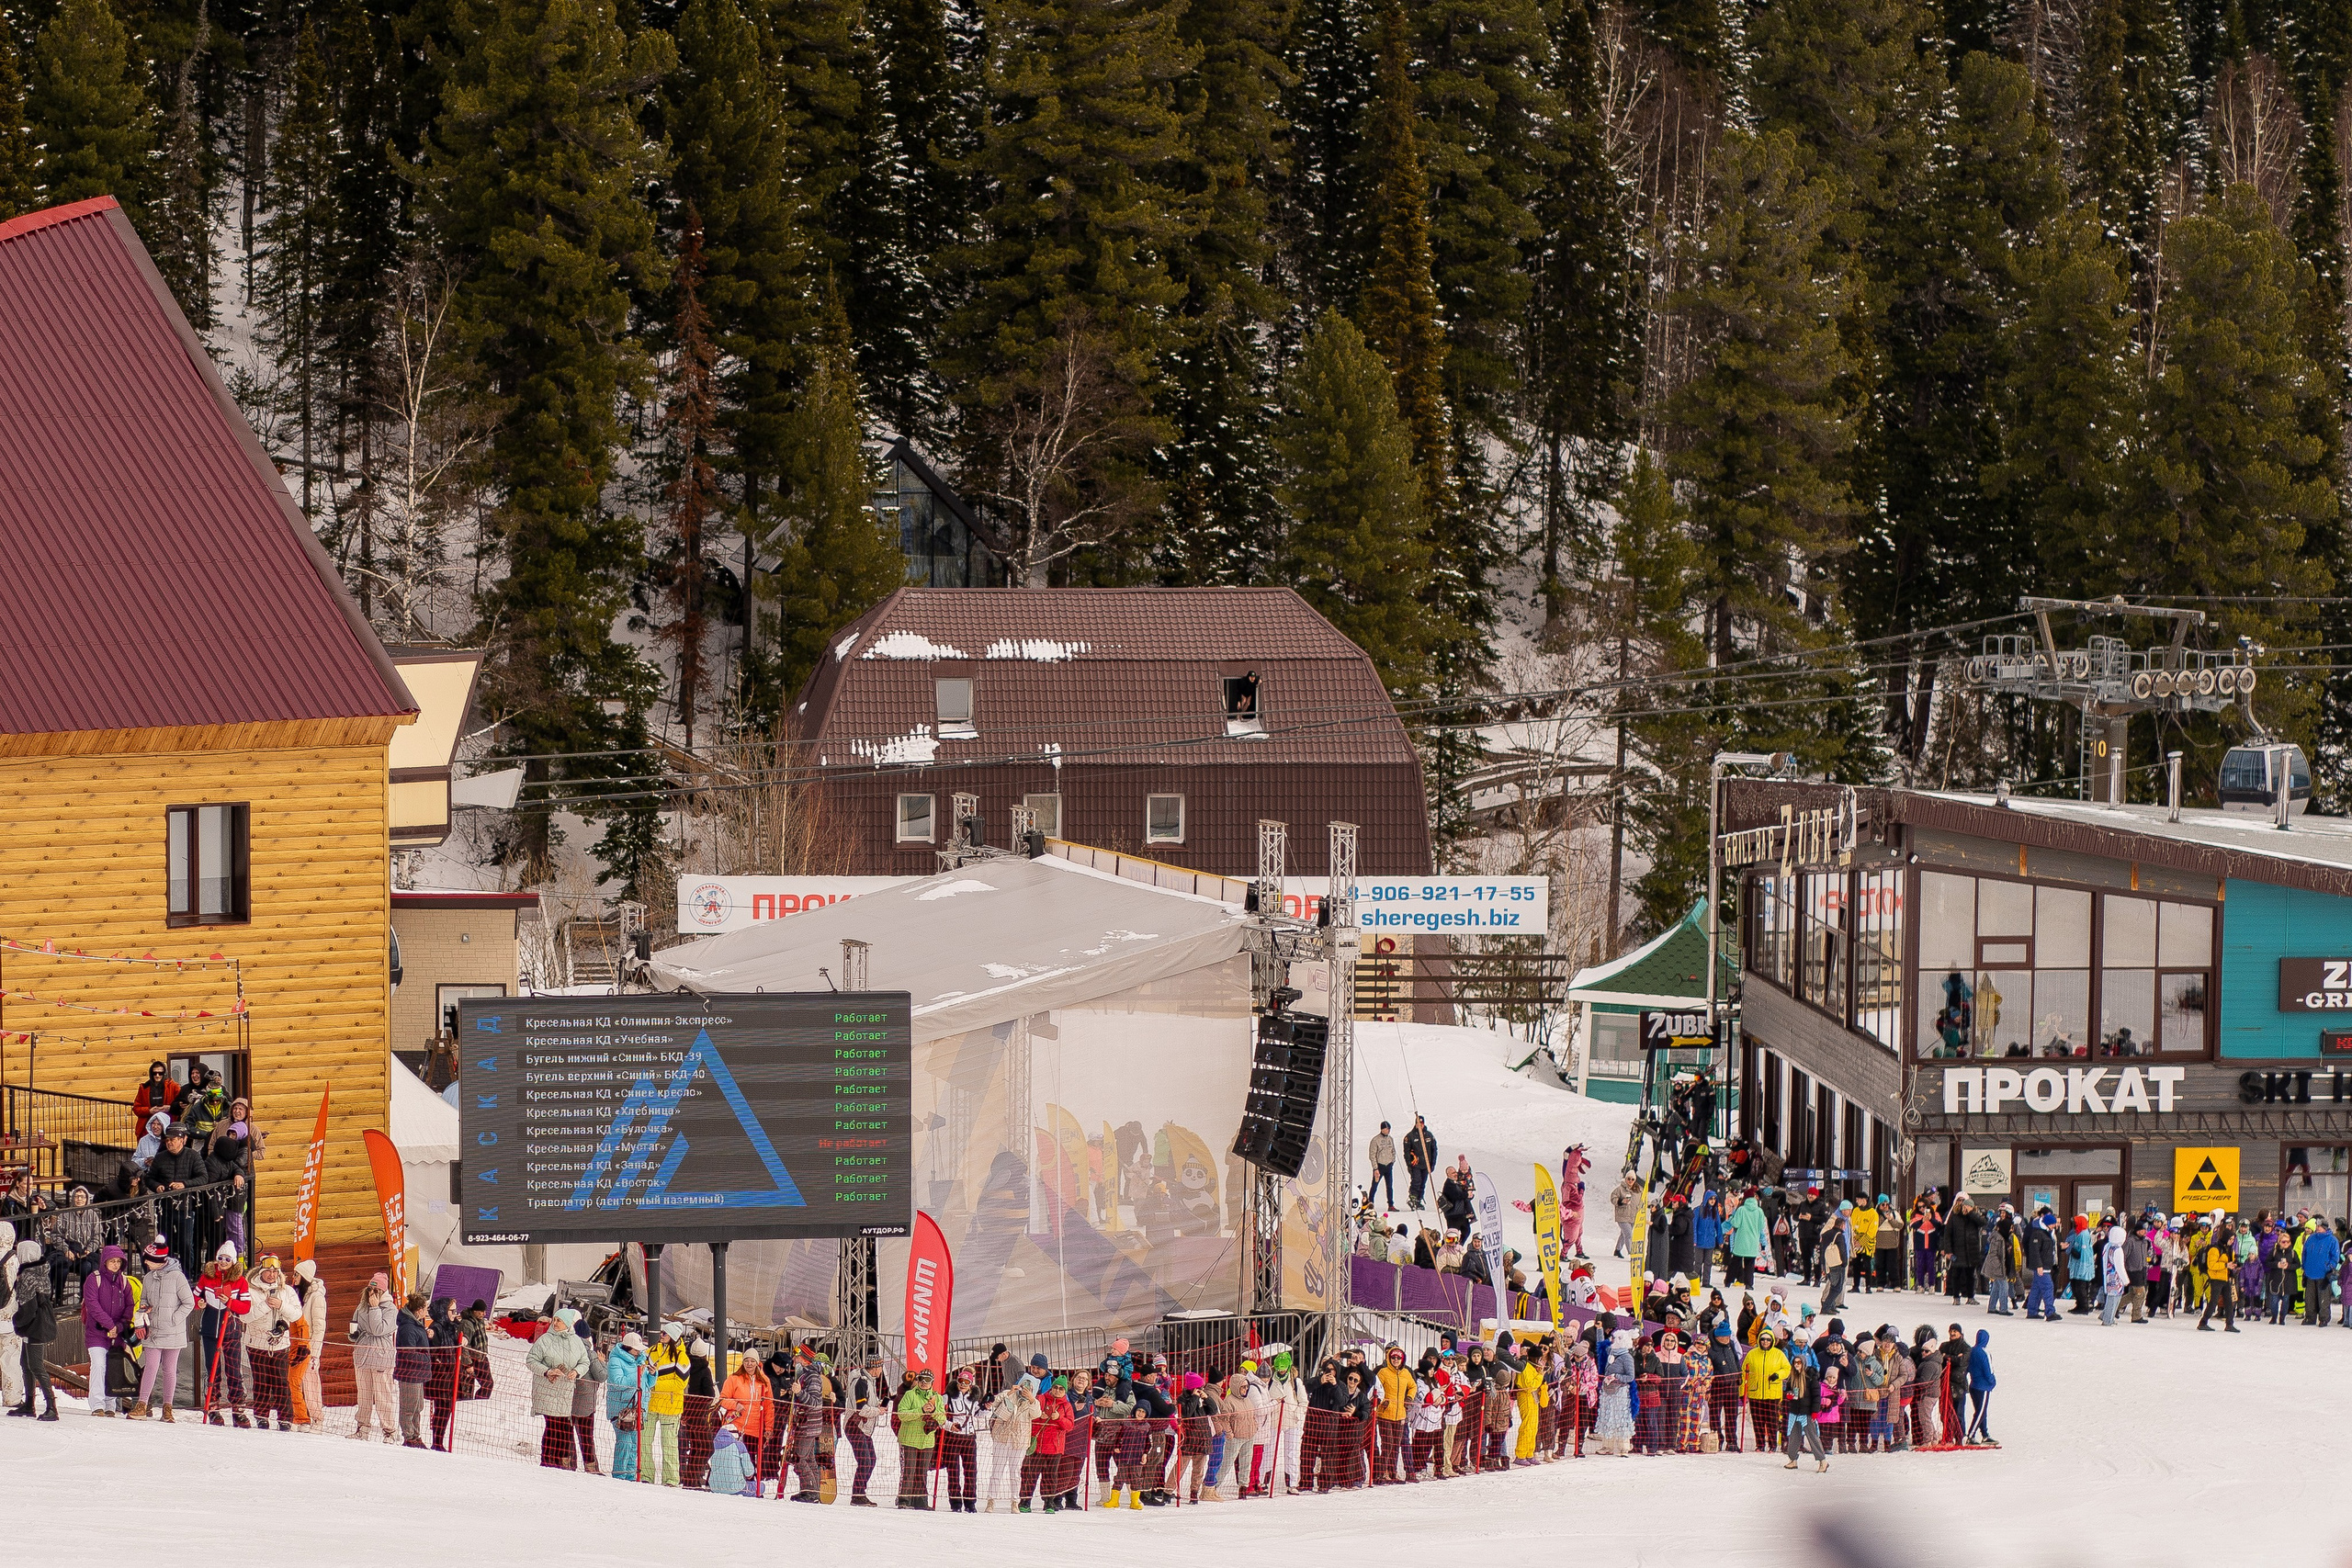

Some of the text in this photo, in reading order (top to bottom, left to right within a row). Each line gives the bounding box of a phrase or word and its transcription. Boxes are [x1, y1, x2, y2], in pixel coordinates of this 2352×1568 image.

[1725, 829, 1774, 866] GRILL BAR
[1780, 804, 1834, 878] ZUBR
[1347, 886, 1535, 901] 8-906-921-17-55
[1361, 908, 1521, 931] sheregesh.biz
[526, 1015, 733, 1030] Кресельная КД «Олимпия-Экспресс»
[834, 1013, 888, 1023] Работает
[1647, 1011, 1713, 1039] ZUBR
[526, 1033, 673, 1048] Кресельная КД «Учебная»
[834, 1031, 888, 1041] Работает
[526, 1051, 702, 1066] Бугель нижний «Синий» БКД-39
[834, 1049, 888, 1059] Работает
[526, 1069, 706, 1083] Бугель верхний «Синий» БКД-40
[834, 1066, 888, 1077] Работает
[834, 1085, 888, 1094] Работает
[1943, 1066, 2185, 1113] ПРОКАТ
[2239, 1071, 2312, 1104] SKI
[526, 1089, 703, 1101] Кресельная КД «Синее кресло»
[526, 1106, 681, 1120] Кресельная КД «Хлебница»
[834, 1102, 888, 1112] Работает
[526, 1123, 673, 1138] Кресельная КД «Булочка»
[834, 1120, 888, 1130] Работает
[526, 1142, 667, 1156] Кресельная КД «Мустаг»
[819, 1137, 888, 1150] Не работает
[526, 1160, 661, 1173] Кресельная КД «Запад»
[834, 1156, 888, 1166] Работает
[526, 1178, 667, 1191] Кресельная КД «Восток»
[834, 1174, 888, 1184] Работает
[526, 1194, 725, 1209] Траволатор (ленточный наземный)
[834, 1191, 888, 1201] Работает
[862, 1226, 905, 1235] АУТДОР.РФ
[468, 1234, 529, 1243] 8-923-464-06-77
